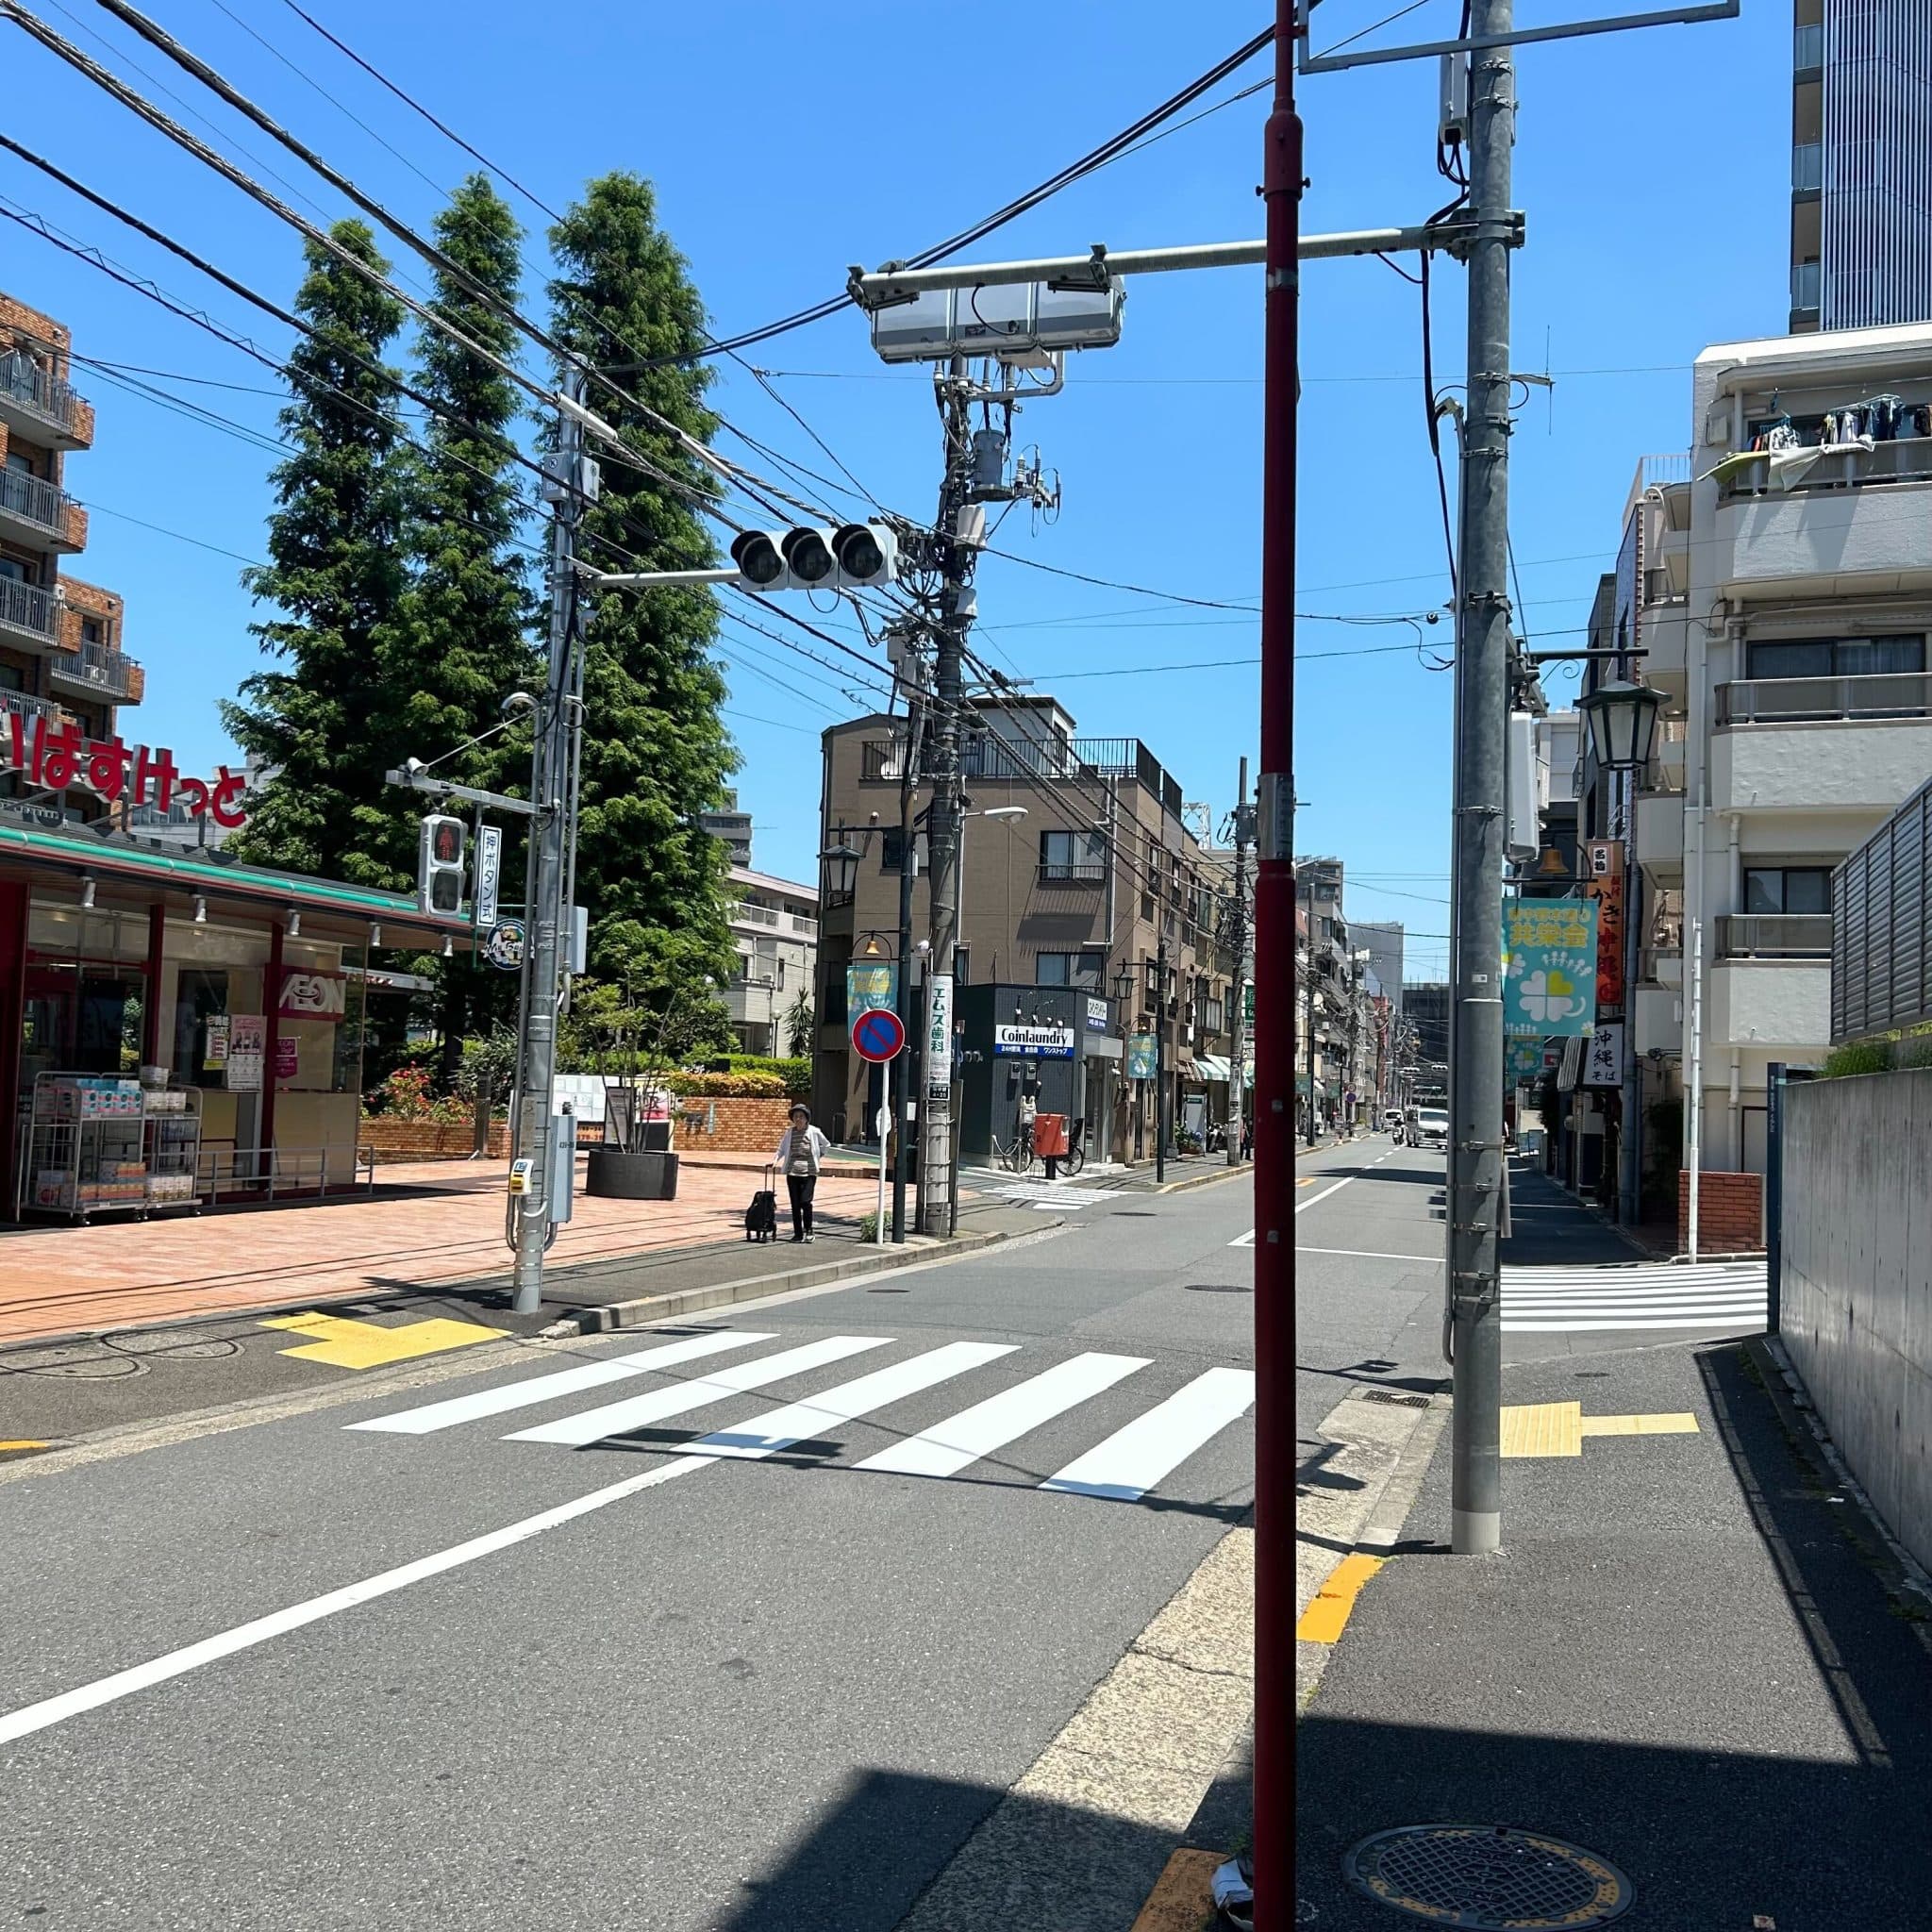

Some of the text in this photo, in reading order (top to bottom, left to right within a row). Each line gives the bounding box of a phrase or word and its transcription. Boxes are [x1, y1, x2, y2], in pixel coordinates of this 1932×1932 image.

[482, 835, 497, 918] 押ボタン式
[1001, 1027, 1068, 1044] Coinlaundry
[1594, 1029, 1615, 1068] 沖縄
